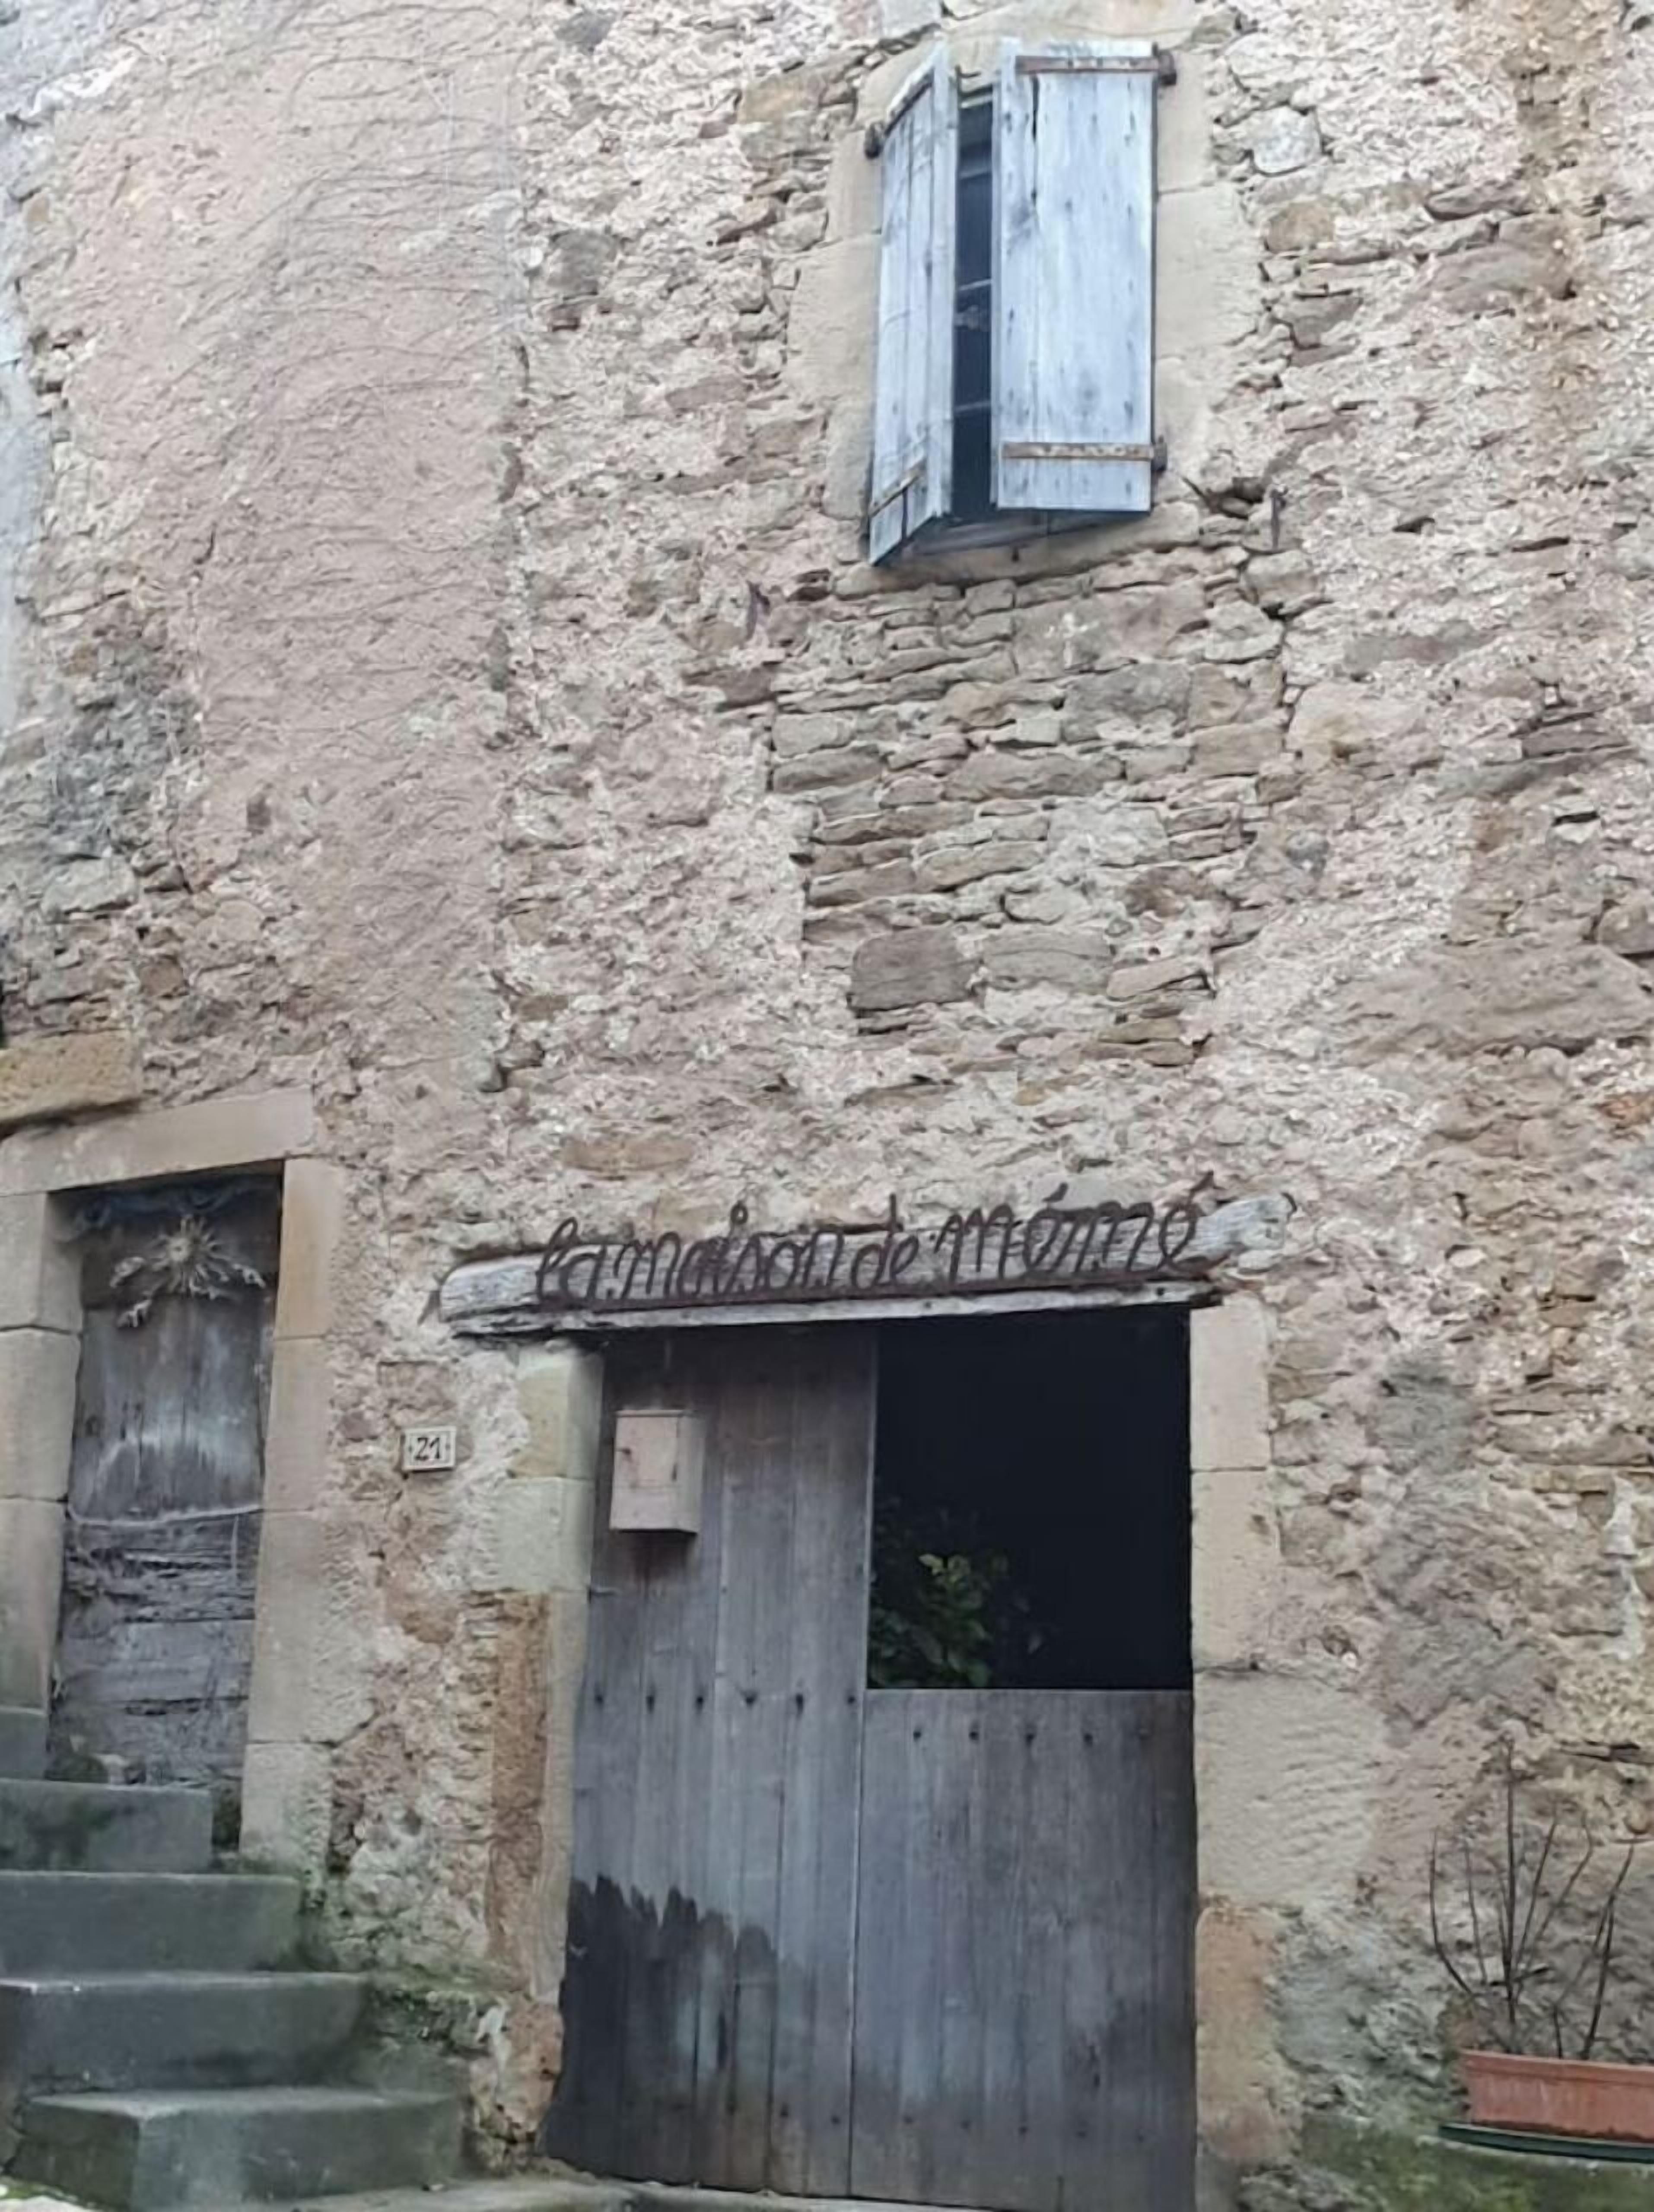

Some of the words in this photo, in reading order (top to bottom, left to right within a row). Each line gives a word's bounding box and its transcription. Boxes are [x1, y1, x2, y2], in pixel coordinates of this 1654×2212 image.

[612, 1201, 845, 1300] maison
[850, 1193, 919, 1292] de
[414, 1437, 441, 1461] 21
